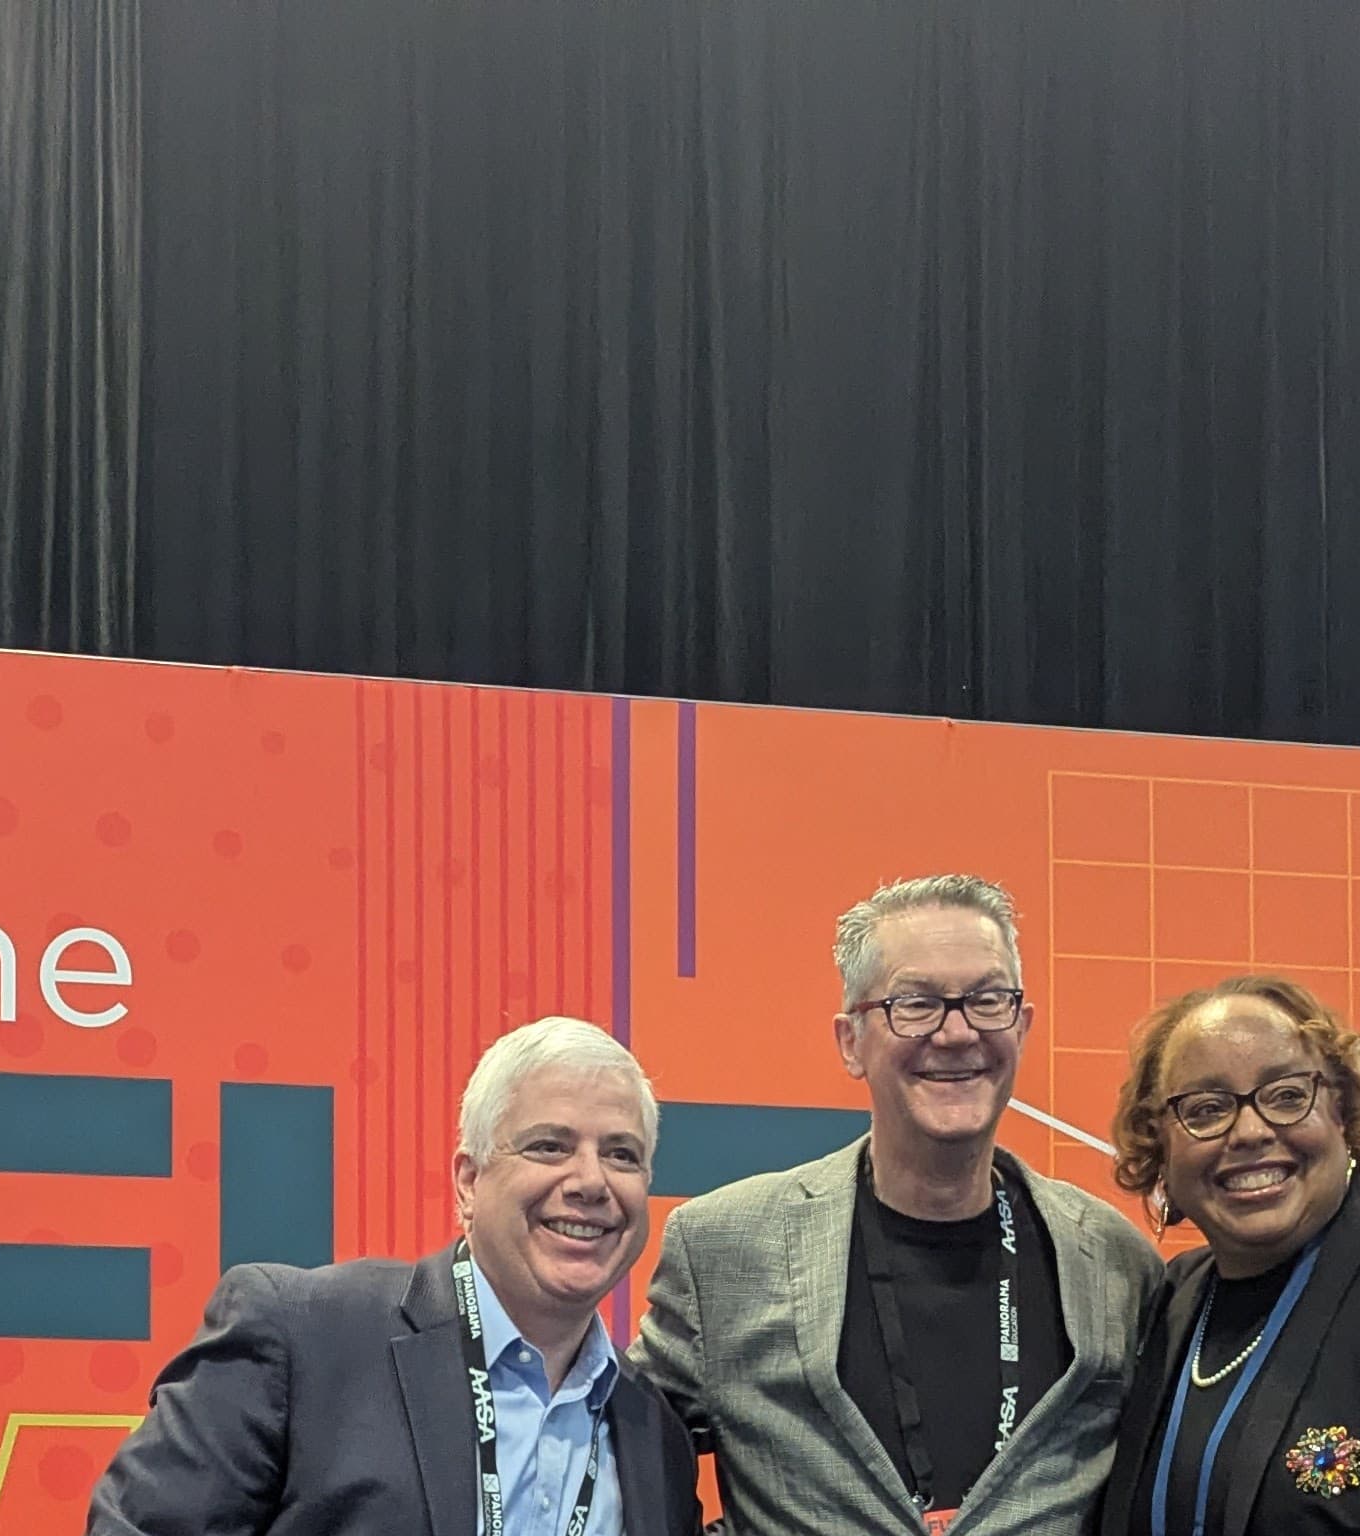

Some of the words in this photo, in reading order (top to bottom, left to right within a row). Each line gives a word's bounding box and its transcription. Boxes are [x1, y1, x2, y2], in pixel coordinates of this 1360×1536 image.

[996, 1190, 1016, 1254] AASA
[462, 1275, 481, 1340] PANORAMA
[999, 1279, 1010, 1343] PANORAMA
[468, 1366, 496, 1443] AASA
